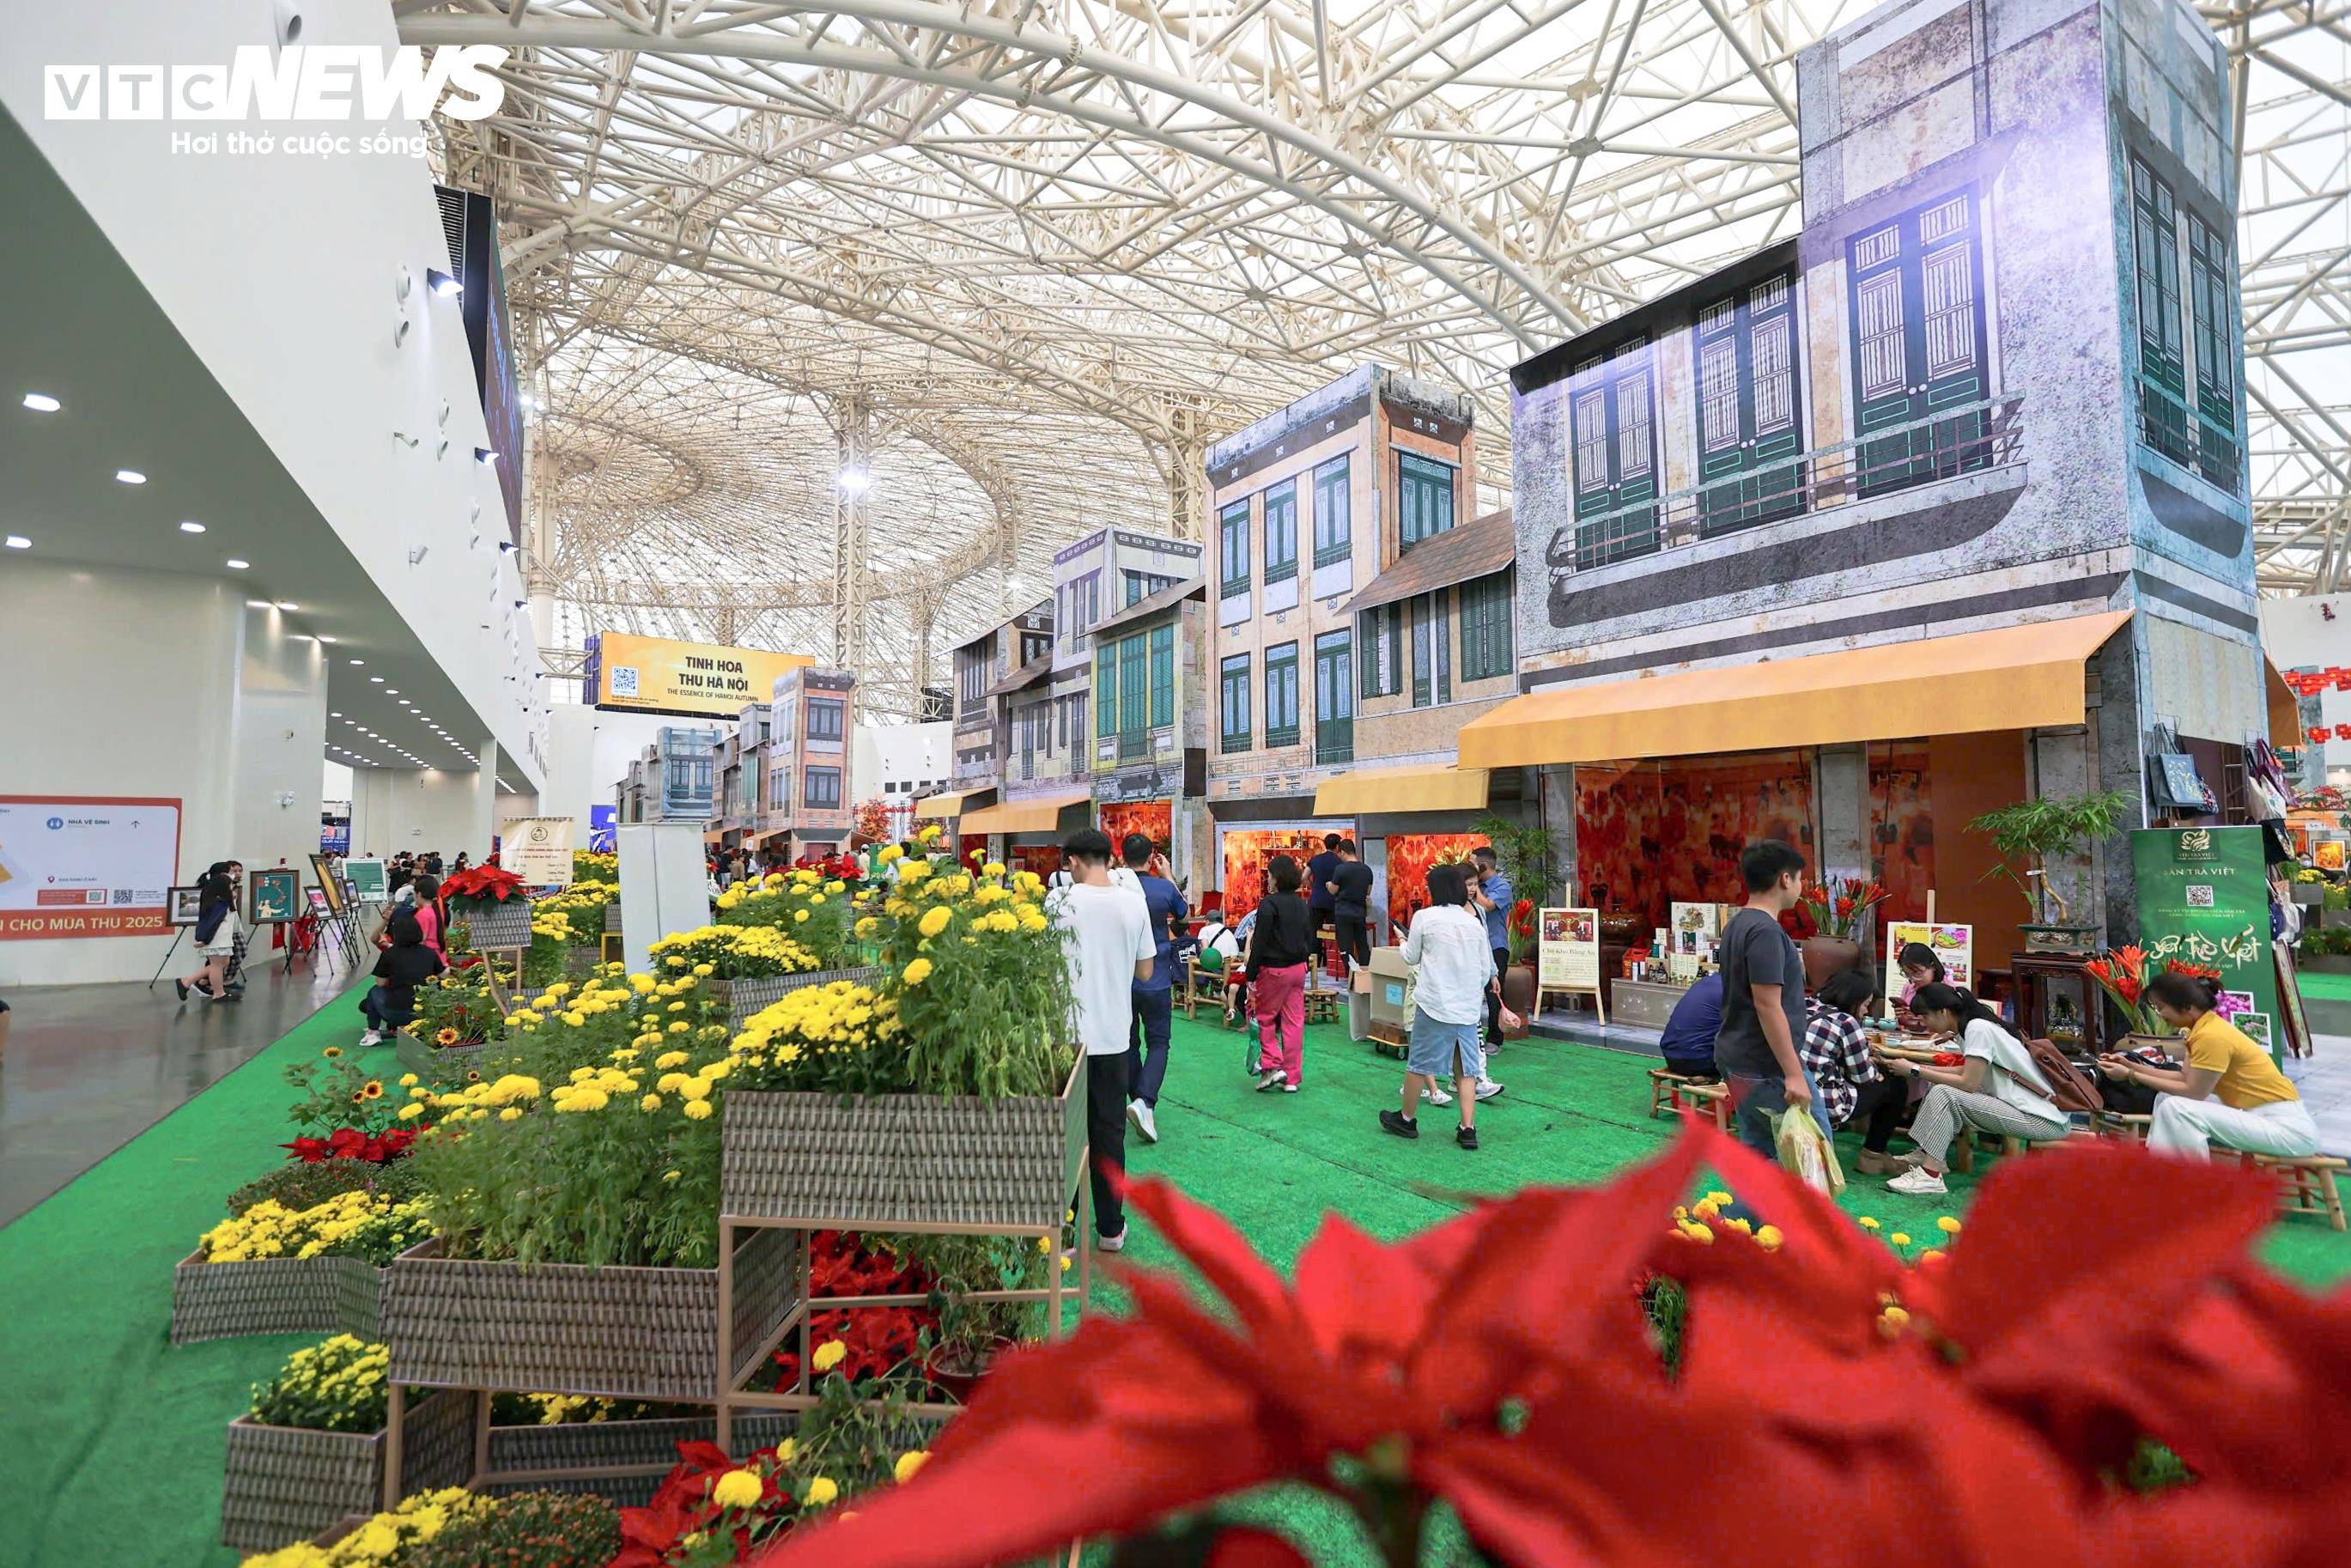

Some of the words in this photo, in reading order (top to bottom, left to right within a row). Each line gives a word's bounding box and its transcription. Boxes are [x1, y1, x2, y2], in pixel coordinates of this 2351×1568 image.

[685, 656, 714, 671] TINH
[718, 659, 743, 674] HOA
[678, 673, 703, 686] THU
[707, 675, 724, 689] HÀ
[727, 678, 749, 692] NỘI
[679, 690, 704, 698] ESSENCE
[735, 694, 759, 702] AUTUMN
[50, 915, 86, 930] MÙA
[90, 916, 120, 929] THU
[125, 915, 163, 928] 2025
